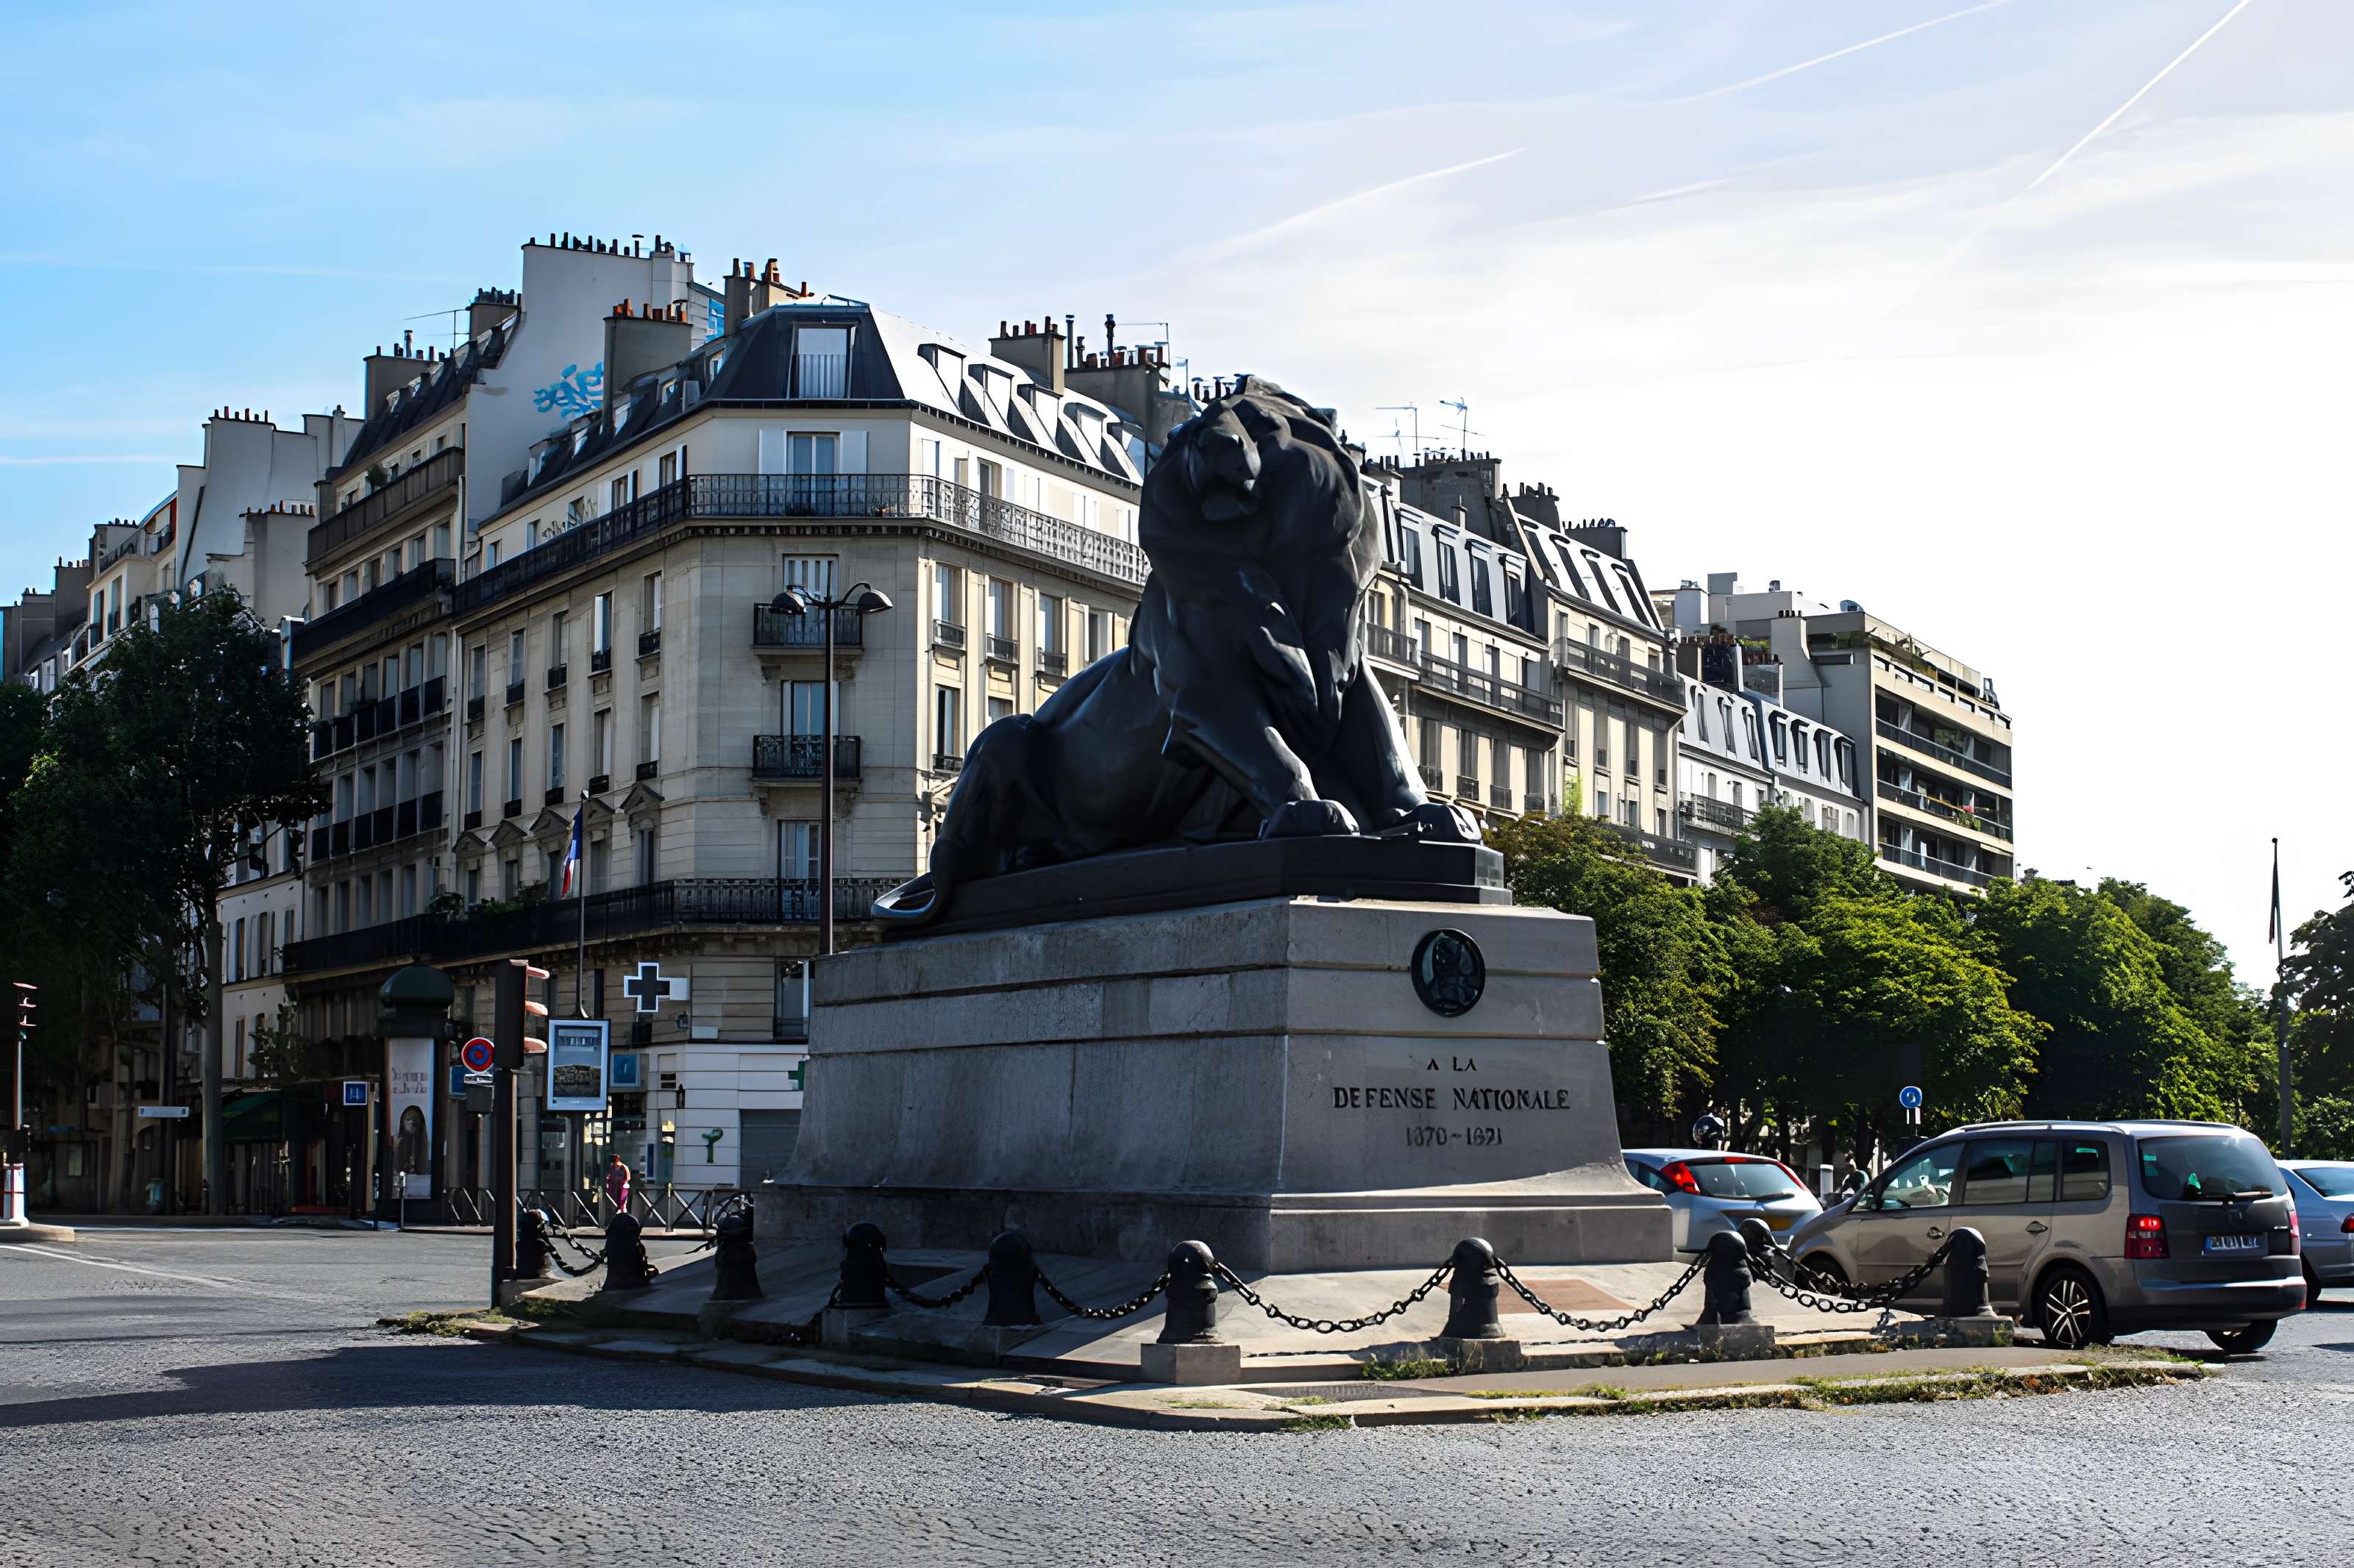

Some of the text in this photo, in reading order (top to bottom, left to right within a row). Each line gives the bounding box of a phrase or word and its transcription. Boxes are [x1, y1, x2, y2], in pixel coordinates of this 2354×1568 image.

[1453, 1056, 1477, 1072] LA
[1333, 1086, 1571, 1111] DEFENSE NATIONALE
